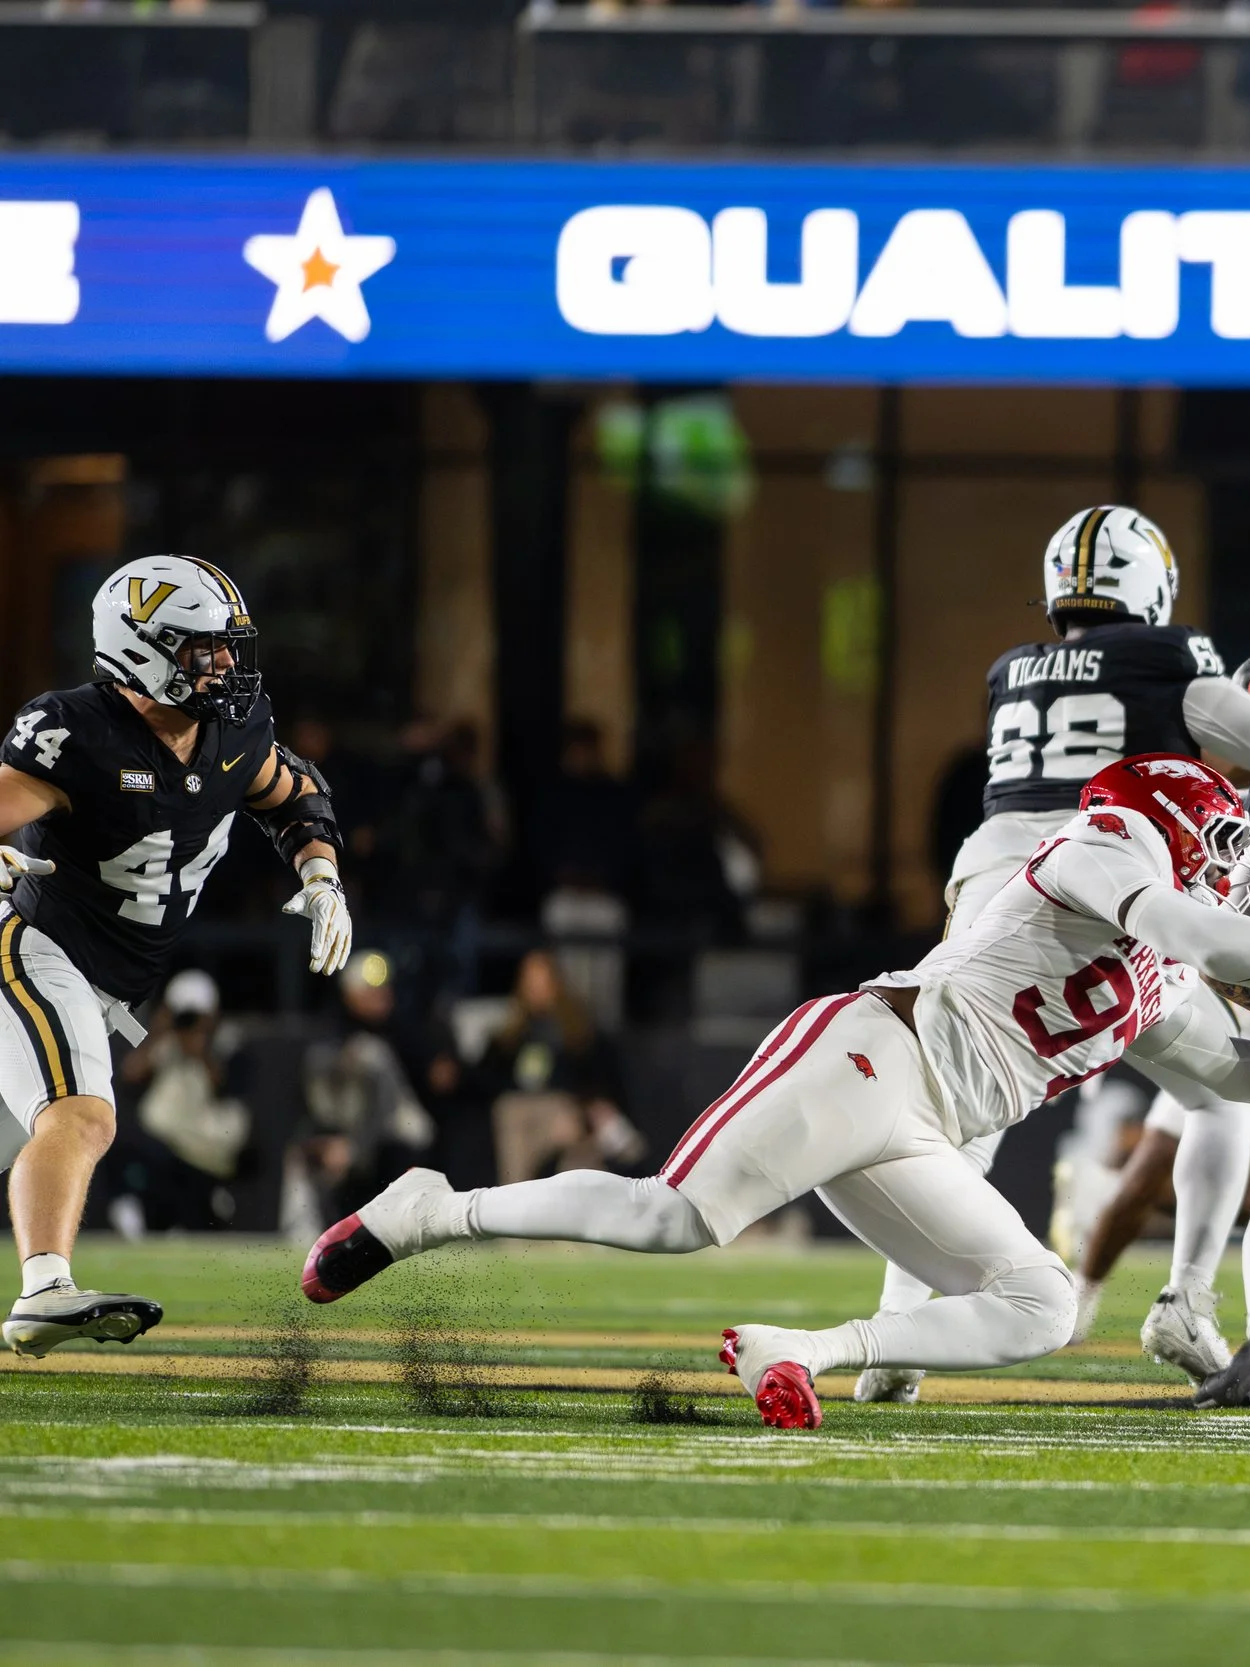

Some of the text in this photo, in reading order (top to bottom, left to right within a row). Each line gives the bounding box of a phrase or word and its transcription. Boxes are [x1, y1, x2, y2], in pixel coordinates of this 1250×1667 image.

[129, 577, 182, 624] V
[1055, 598, 1116, 609] VANDERBILT
[1008, 649, 1103, 690] WILLIAMS
[11, 709, 71, 770] 44
[987, 693, 1126, 786] 62
[128, 773, 153, 785] SRM
[186, 775, 202, 793] SEC
[98, 810, 236, 926] 44
